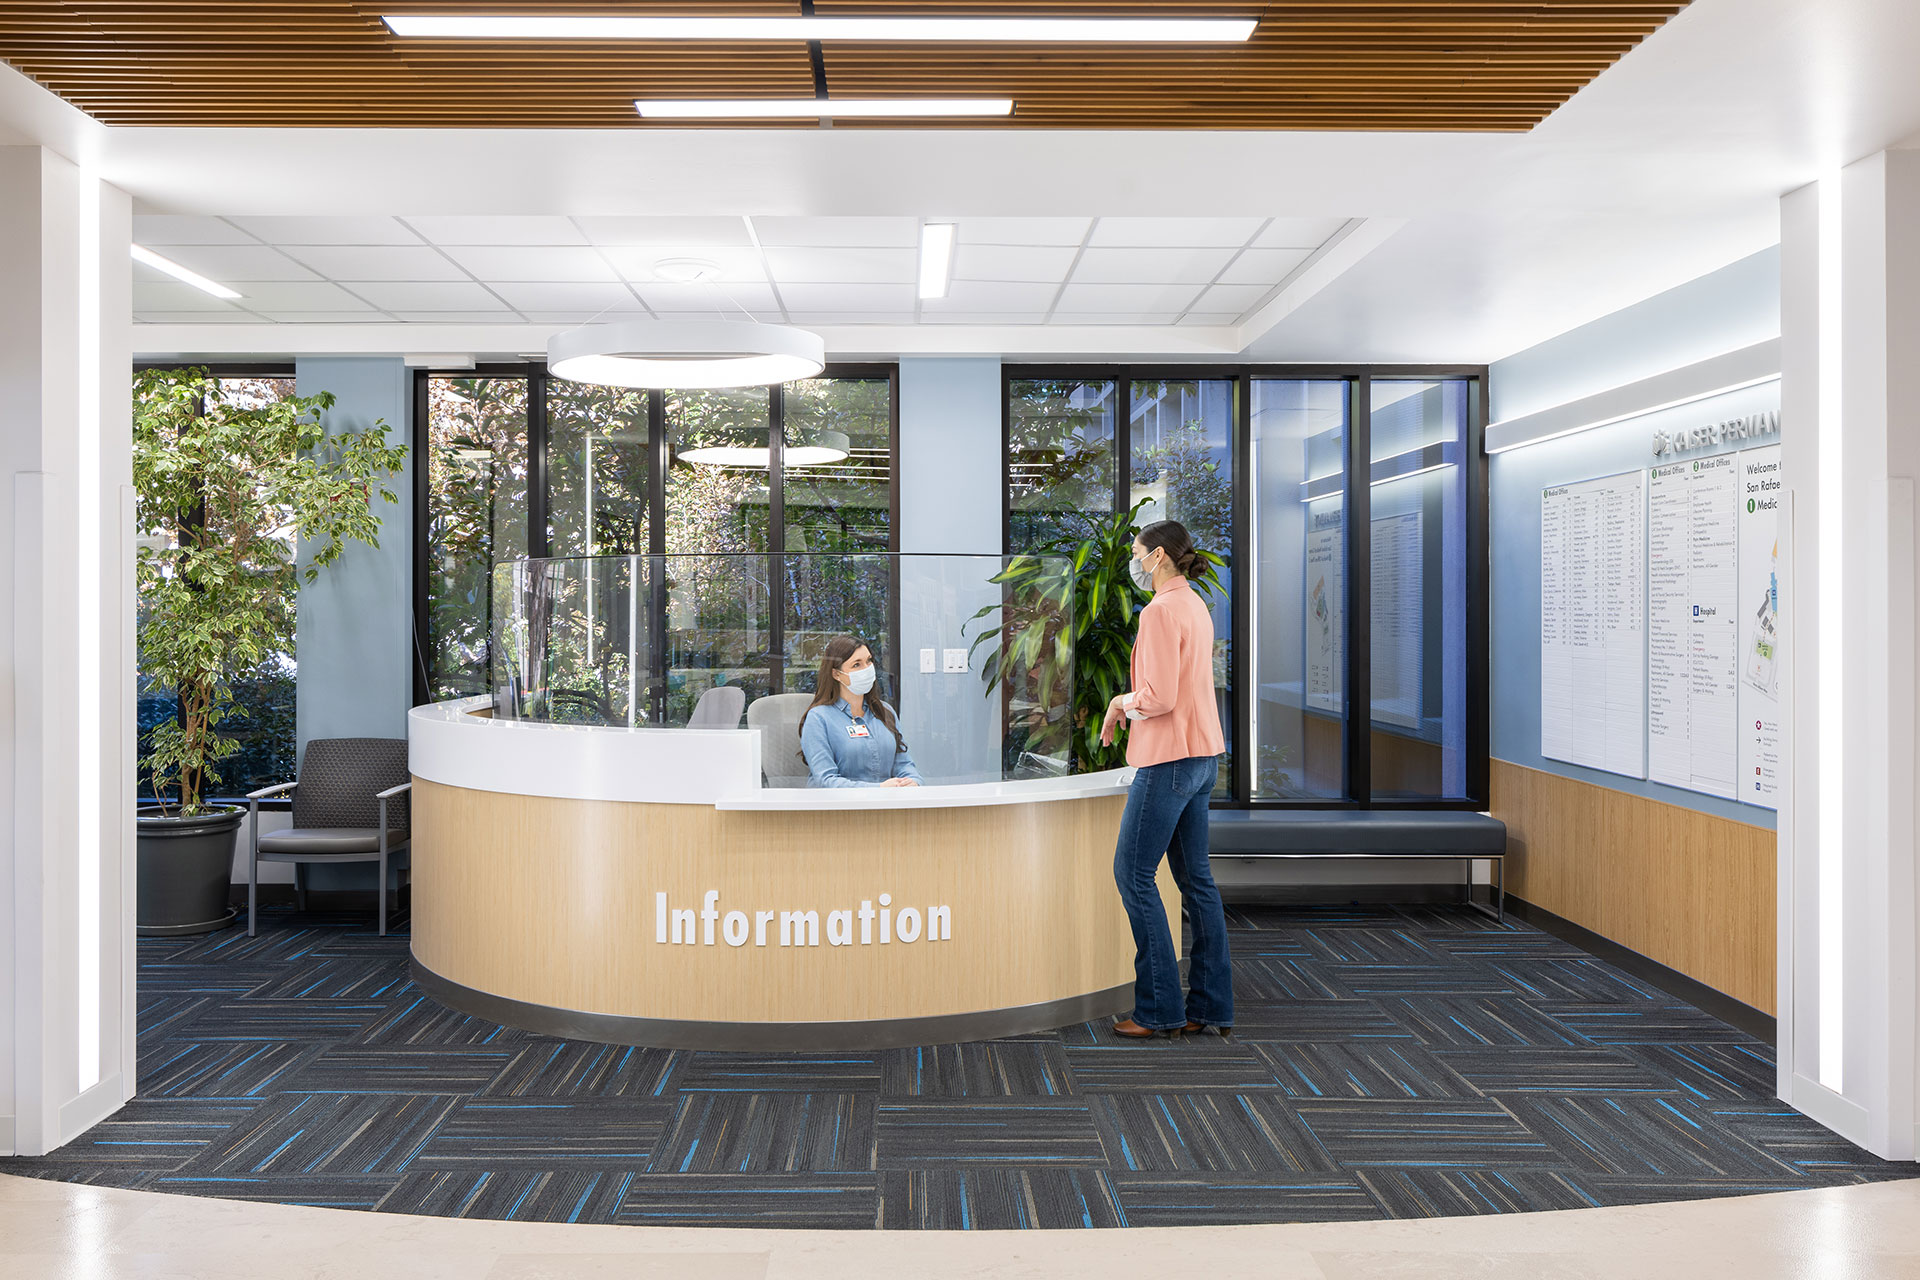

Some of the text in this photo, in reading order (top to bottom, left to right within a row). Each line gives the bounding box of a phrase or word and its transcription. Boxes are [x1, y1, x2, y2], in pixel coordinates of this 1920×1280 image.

[1673, 425, 1718, 453] KAISER
[1700, 460, 1714, 470] Medical
[1715, 458, 1730, 467] Offices
[1746, 462, 1777, 475] Welcome
[1658, 467, 1671, 477] Medical
[1672, 465, 1685, 474] Offices
[1746, 482, 1759, 493] San
[656, 890, 951, 947] Information
